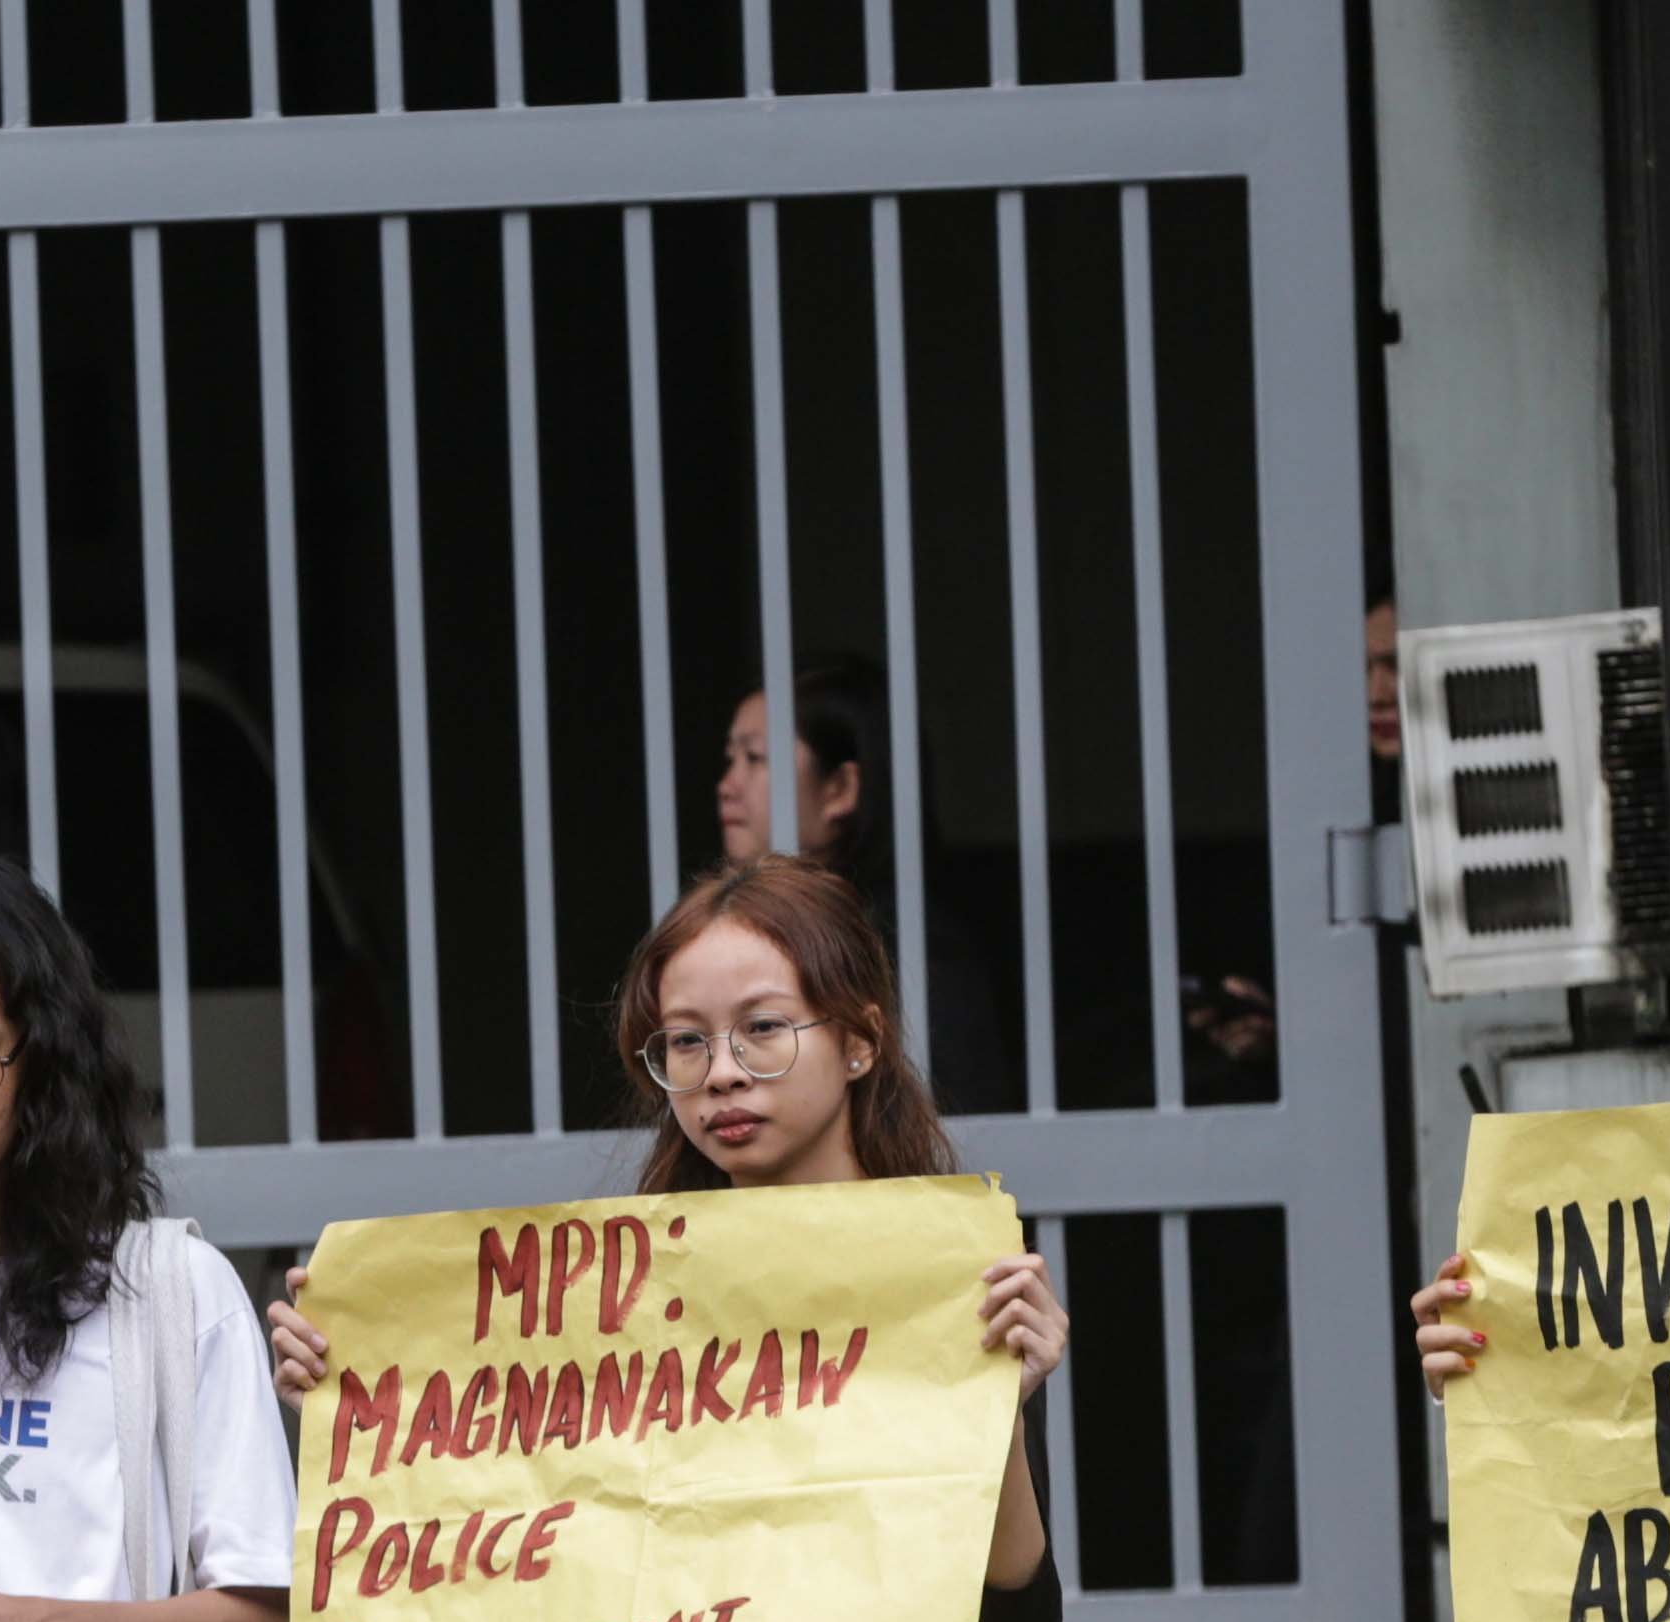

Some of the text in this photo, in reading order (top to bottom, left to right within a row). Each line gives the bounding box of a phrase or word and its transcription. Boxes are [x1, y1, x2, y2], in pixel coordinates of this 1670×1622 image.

[475, 1215, 687, 1342] MPD:
[329, 1326, 868, 1484] MAGNANAKAW
[311, 1496, 576, 1612] POLICE
